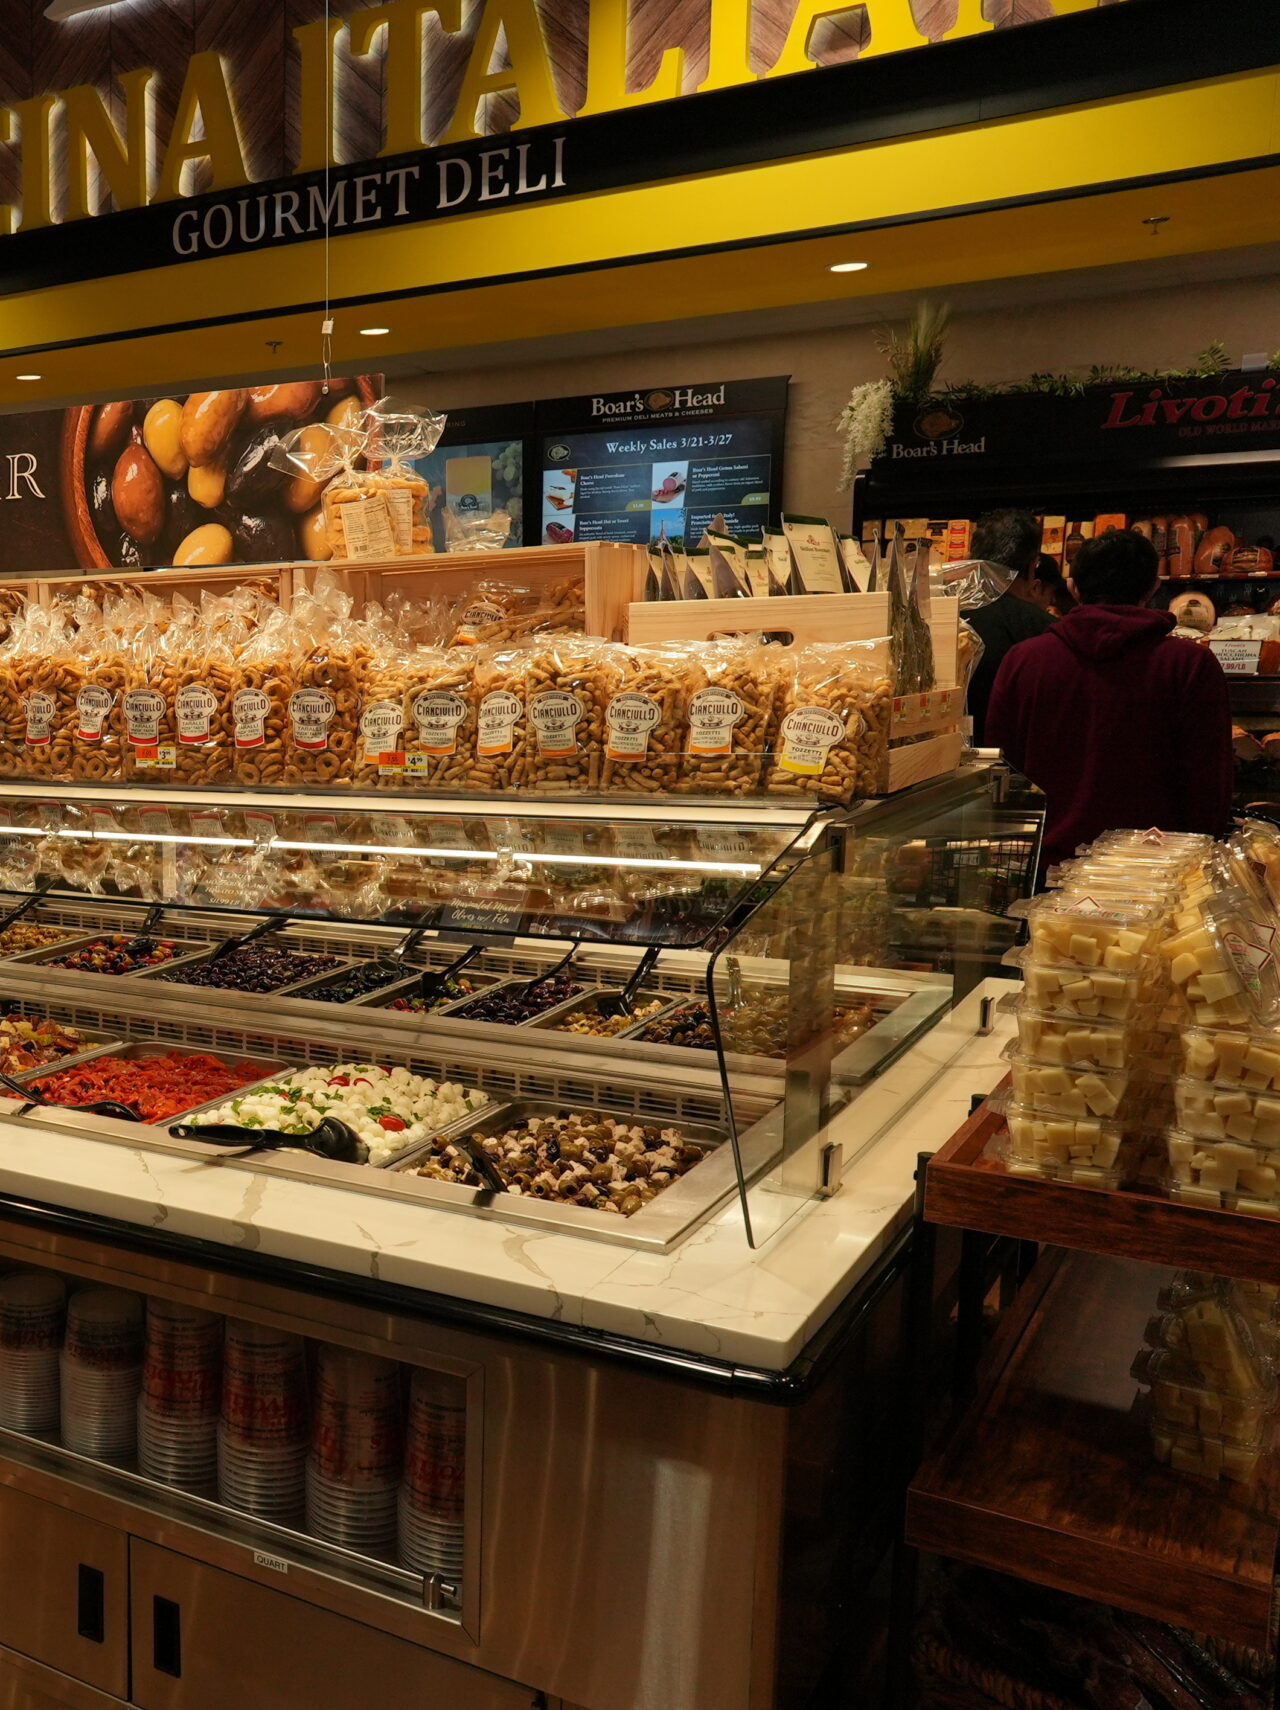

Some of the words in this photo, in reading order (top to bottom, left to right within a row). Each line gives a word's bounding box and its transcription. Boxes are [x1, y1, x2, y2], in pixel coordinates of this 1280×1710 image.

[293, 0, 1104, 168] ITALI
[172, 168, 420, 256] GOURMET
[436, 136, 567, 209] DELI
[592, 393, 644, 416] Boar's
[674, 385, 725, 408] Head
[1100, 377, 1280, 430] Livoti
[606, 440, 647, 454] Weekly
[649, 438, 677, 450] Sales
[680, 434, 733, 448] 3/21-3/27
[892, 440, 937, 459] Boar's
[941, 436, 985, 456] Head
[292, 700, 330, 712] CIANCIULLO
[417, 703, 461, 717] CIANCIULLO
[479, 702, 517, 719] CIANCIULLO
[532, 703, 577, 719] CIANCIULLO
[610, 705, 655, 721] CIANCIULLO
[690, 702, 738, 716] CIANCIULLO
[364, 714, 402, 728] CIANCIULLO
[787, 718, 839, 737] CIANCIULLO
[791, 746, 822, 756] TOZZETTI
[451, 908, 475, 922] Olives
[492, 913, 511, 924] Feta
[256, 1556, 286, 1572] QUART
